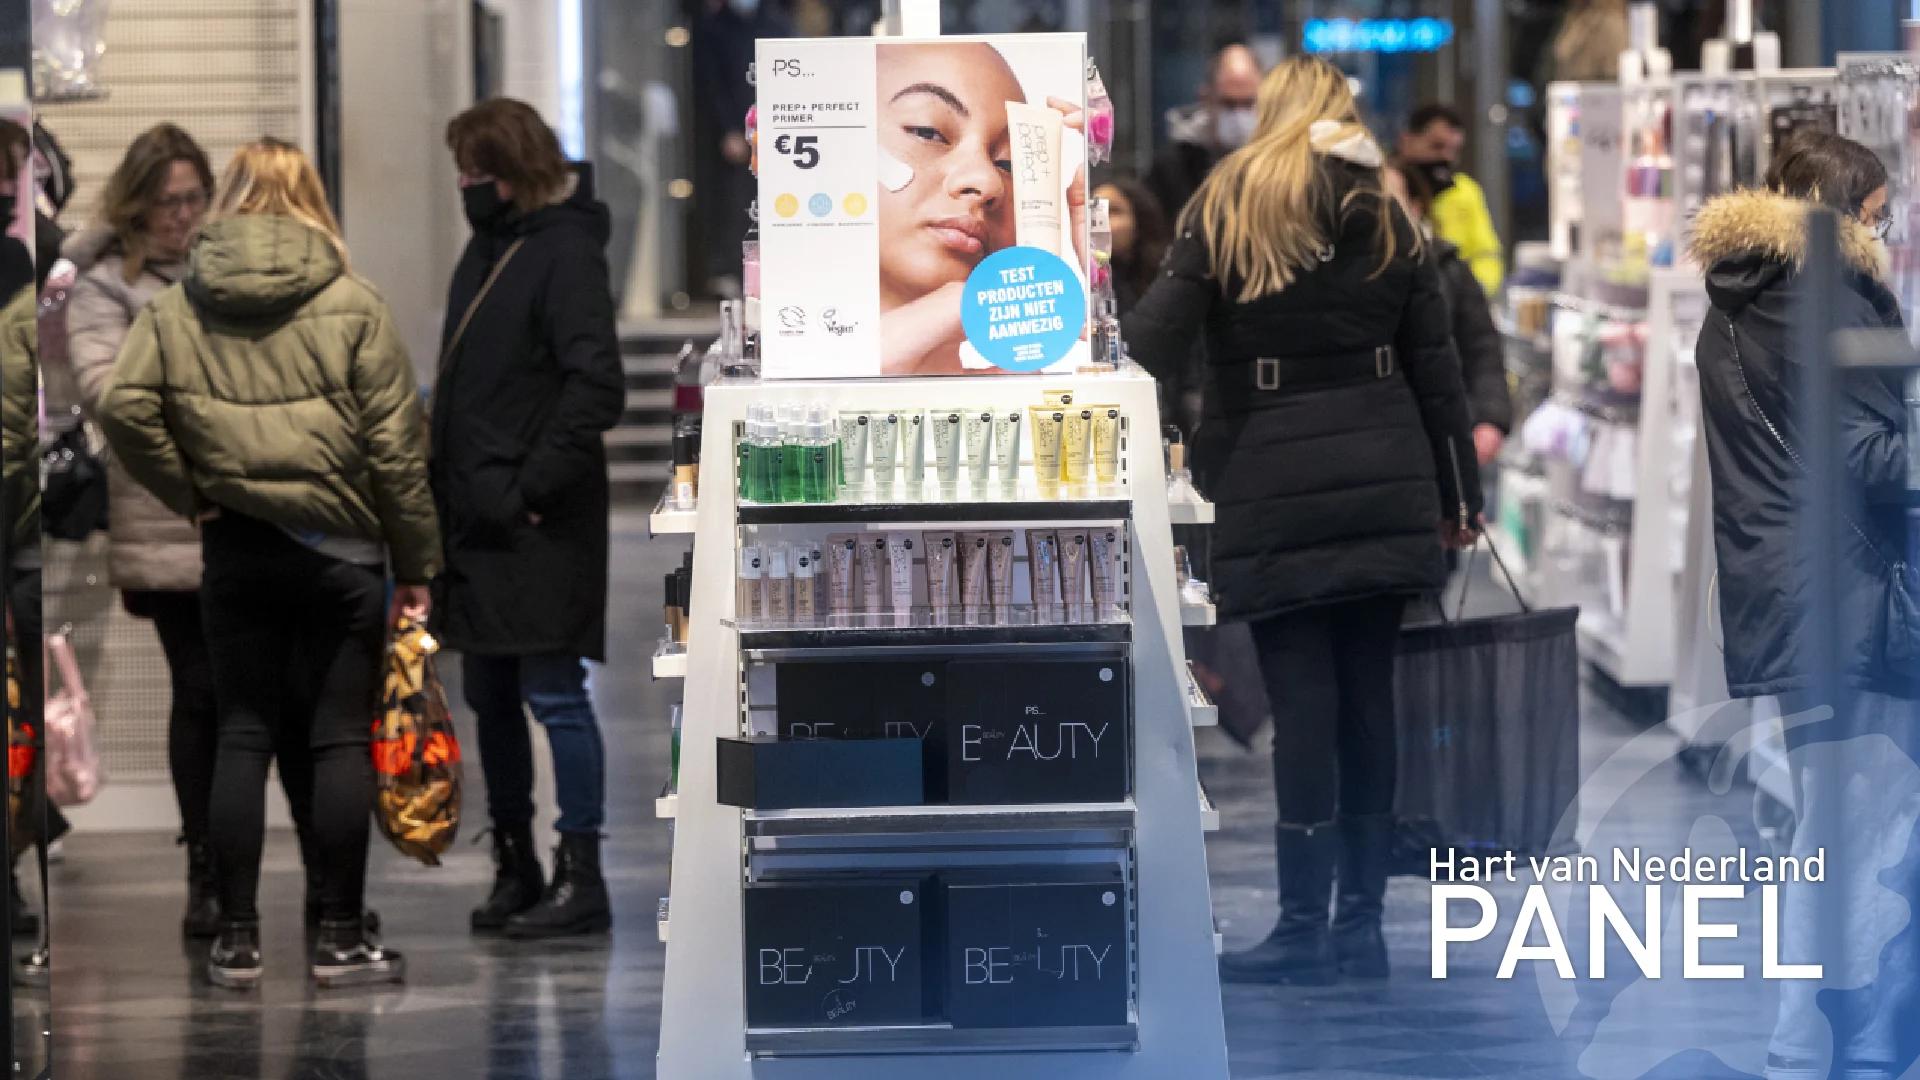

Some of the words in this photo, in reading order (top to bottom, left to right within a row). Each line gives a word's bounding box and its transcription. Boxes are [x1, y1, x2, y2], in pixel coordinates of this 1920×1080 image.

[772, 114, 814, 123] PRIMER
[811, 102, 860, 112] PERFECT
[774, 134, 821, 170] €5
[999, 265, 1035, 285] TEST
[977, 280, 1064, 307] PRODUCTEN
[989, 304, 1020, 322] ZIJN
[1023, 298, 1056, 317] NIET
[989, 315, 1064, 341] AANWEZIG
